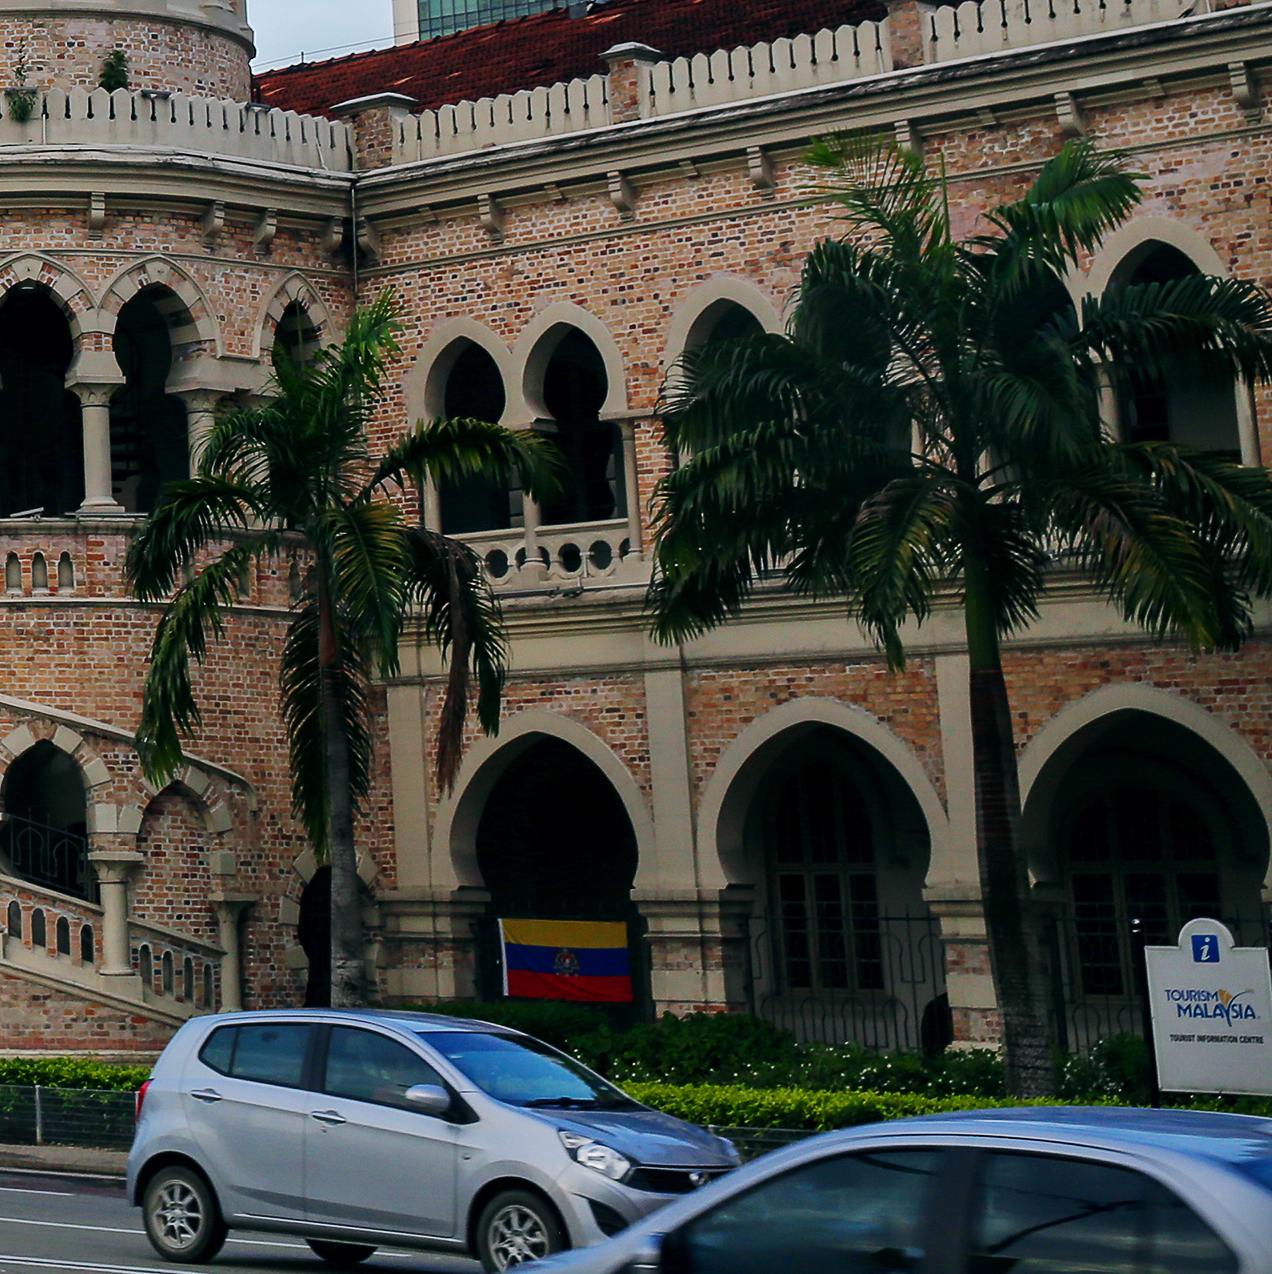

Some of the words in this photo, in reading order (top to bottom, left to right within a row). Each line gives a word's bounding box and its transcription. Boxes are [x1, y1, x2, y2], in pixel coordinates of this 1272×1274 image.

[1164, 989, 1219, 1002] TOURISM
[1176, 1002, 1257, 1027] MALAYSIA
[1169, 1034, 1196, 1043] TOURIST
[1197, 1035, 1238, 1043] INFORMATION
[1239, 1035, 1264, 1044] CENTRE
